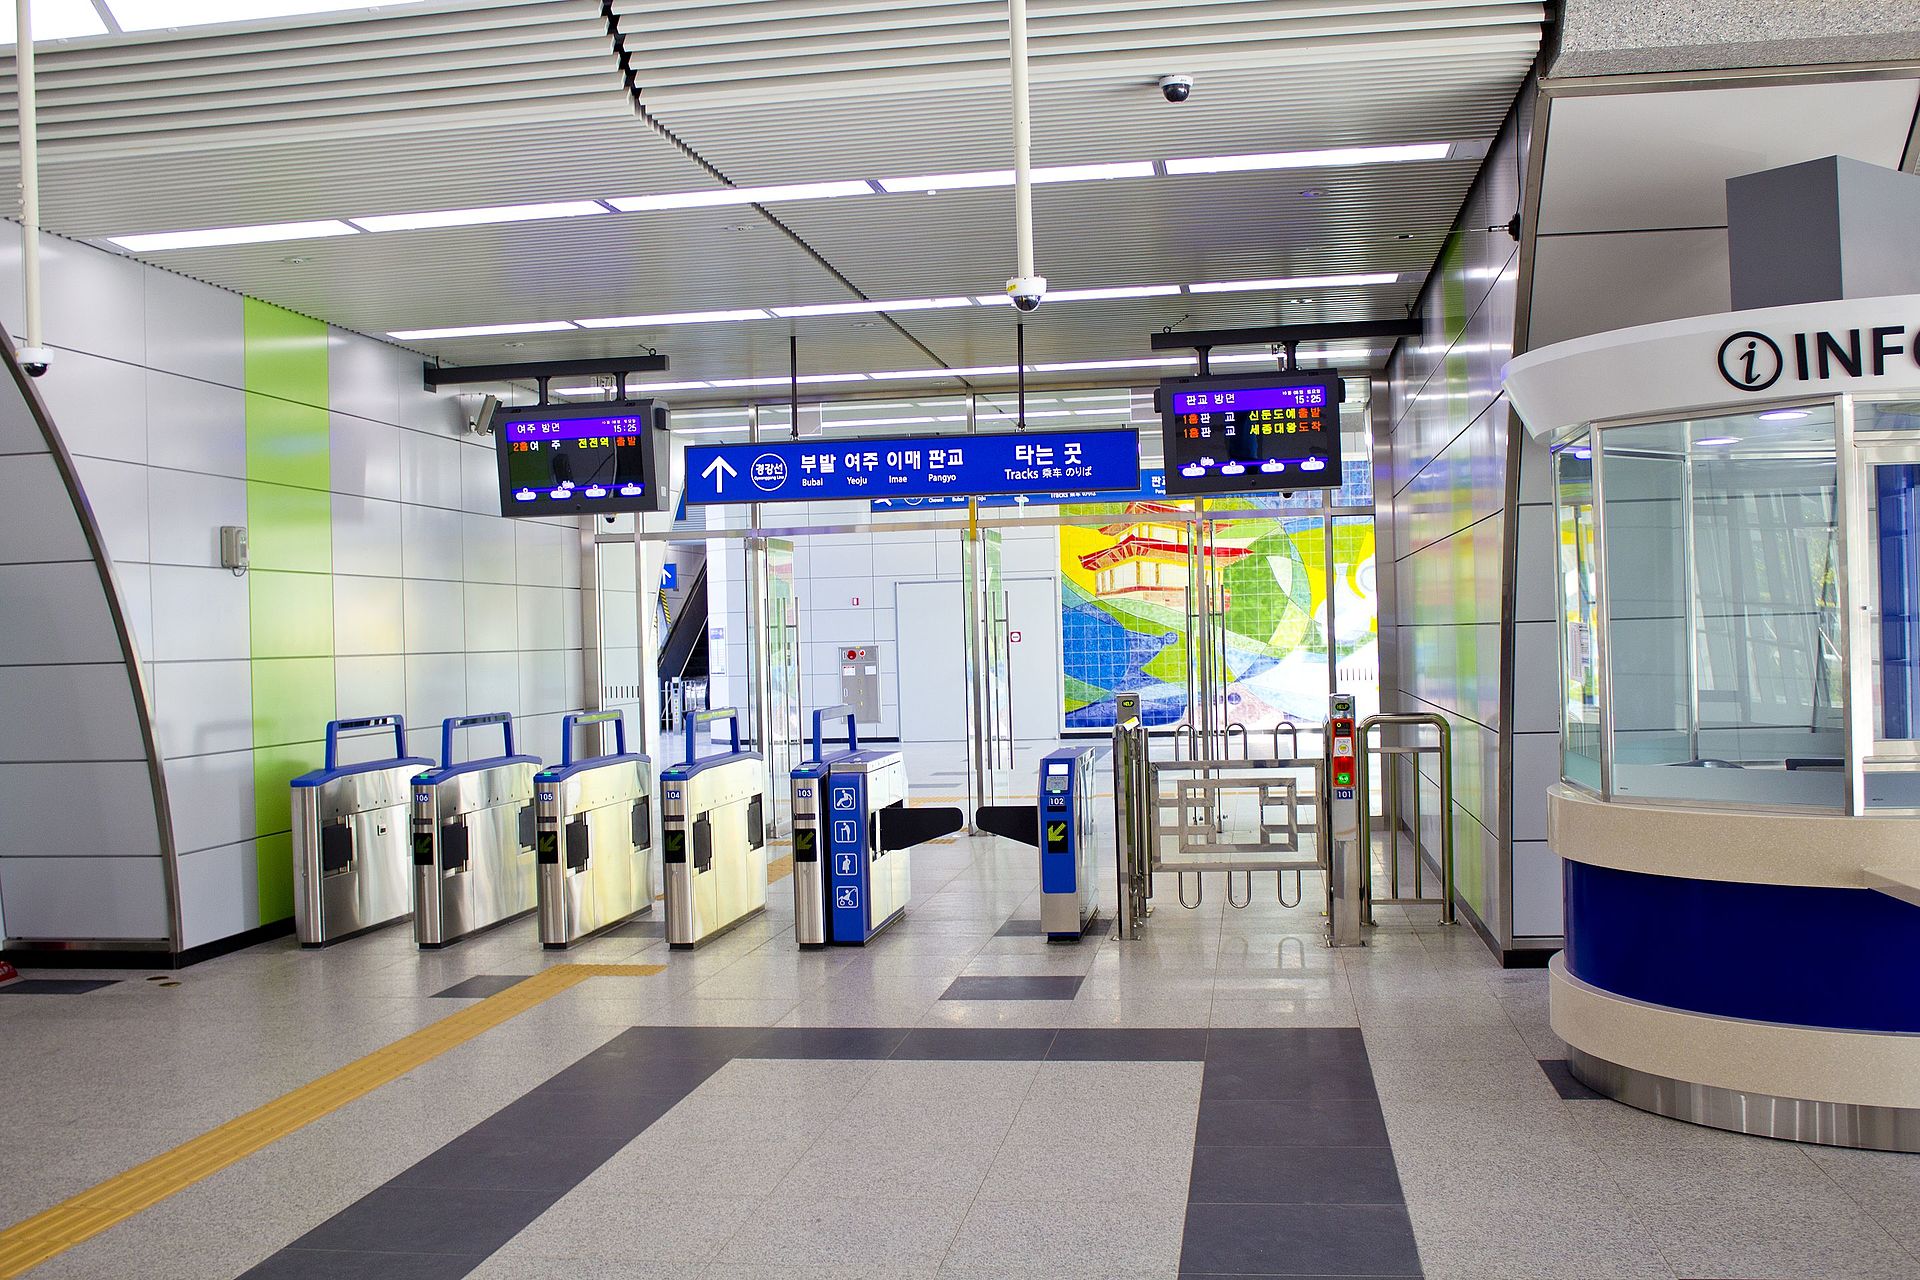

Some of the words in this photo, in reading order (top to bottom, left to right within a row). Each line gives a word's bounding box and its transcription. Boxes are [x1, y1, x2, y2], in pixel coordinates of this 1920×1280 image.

[1794, 325, 1920, 381] INF
[1186, 394, 1208, 405] 판교
[1214, 393, 1235, 404] 방면
[1295, 394, 1321, 405] 15:25
[517, 423, 536, 434] 여주
[541, 422, 560, 433] 방면
[613, 423, 637, 433] 15:25
[578, 436, 609, 449] 전전역
[1015, 444, 1054, 466] 타는
[1063, 442, 1082, 465] 곳
[801, 453, 837, 474] 부발
[844, 452, 879, 473] 여주
[886, 450, 921, 471] 이매
[928, 448, 964, 470] 판교
[755, 462, 784, 476] 경강선
[1003, 467, 1039, 480] Tracks
[1065, 465, 1093, 478] のりば
[801, 477, 824, 487] Bubal
[846, 476, 868, 487] Yeoju
[888, 475, 908, 484] Imae
[928, 473, 957, 484] Pangyo
[415, 794, 429, 802] 106
[539, 793, 553, 801] 105
[666, 791, 680, 799] 104
[798, 789, 811, 797] 103
[1337, 790, 1351, 798] 101
[1050, 797, 1064, 805] 102
